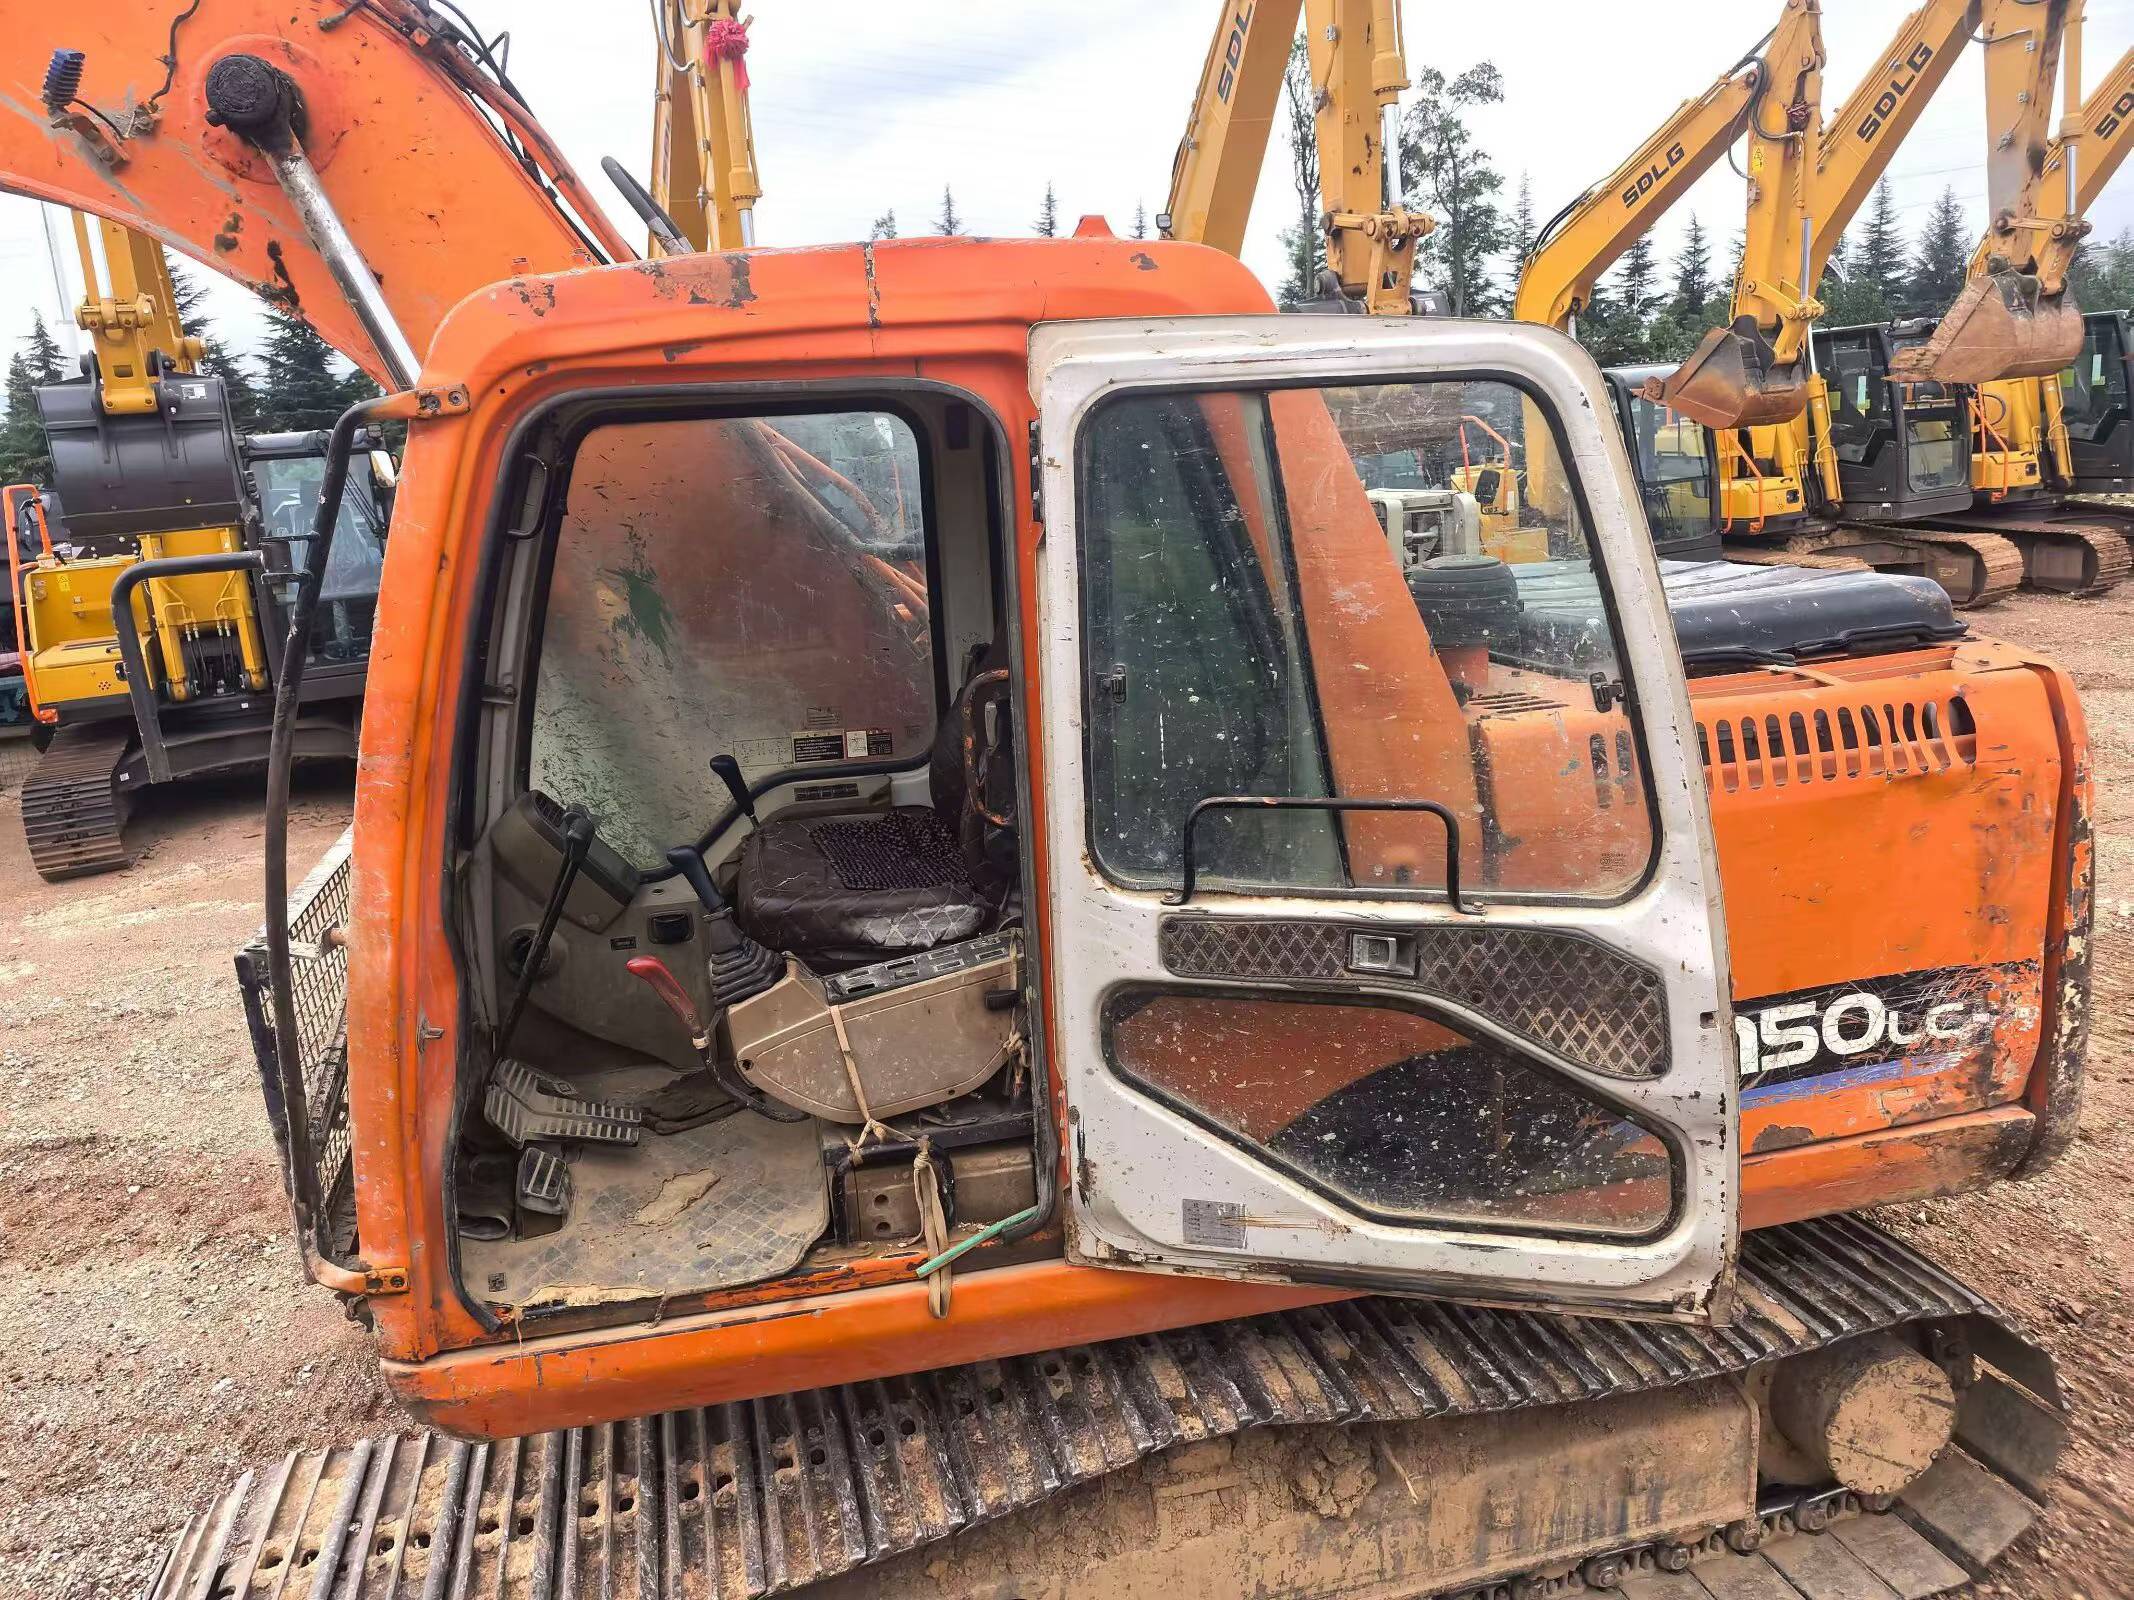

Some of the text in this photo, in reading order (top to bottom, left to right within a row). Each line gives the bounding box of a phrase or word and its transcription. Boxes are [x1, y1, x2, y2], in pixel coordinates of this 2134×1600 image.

[1217, 0, 1254, 105] SDL
[1857, 42, 1933, 143] SDLG
[2094, 82, 2134, 140] SD
[1622, 142, 1685, 208] SDLG
